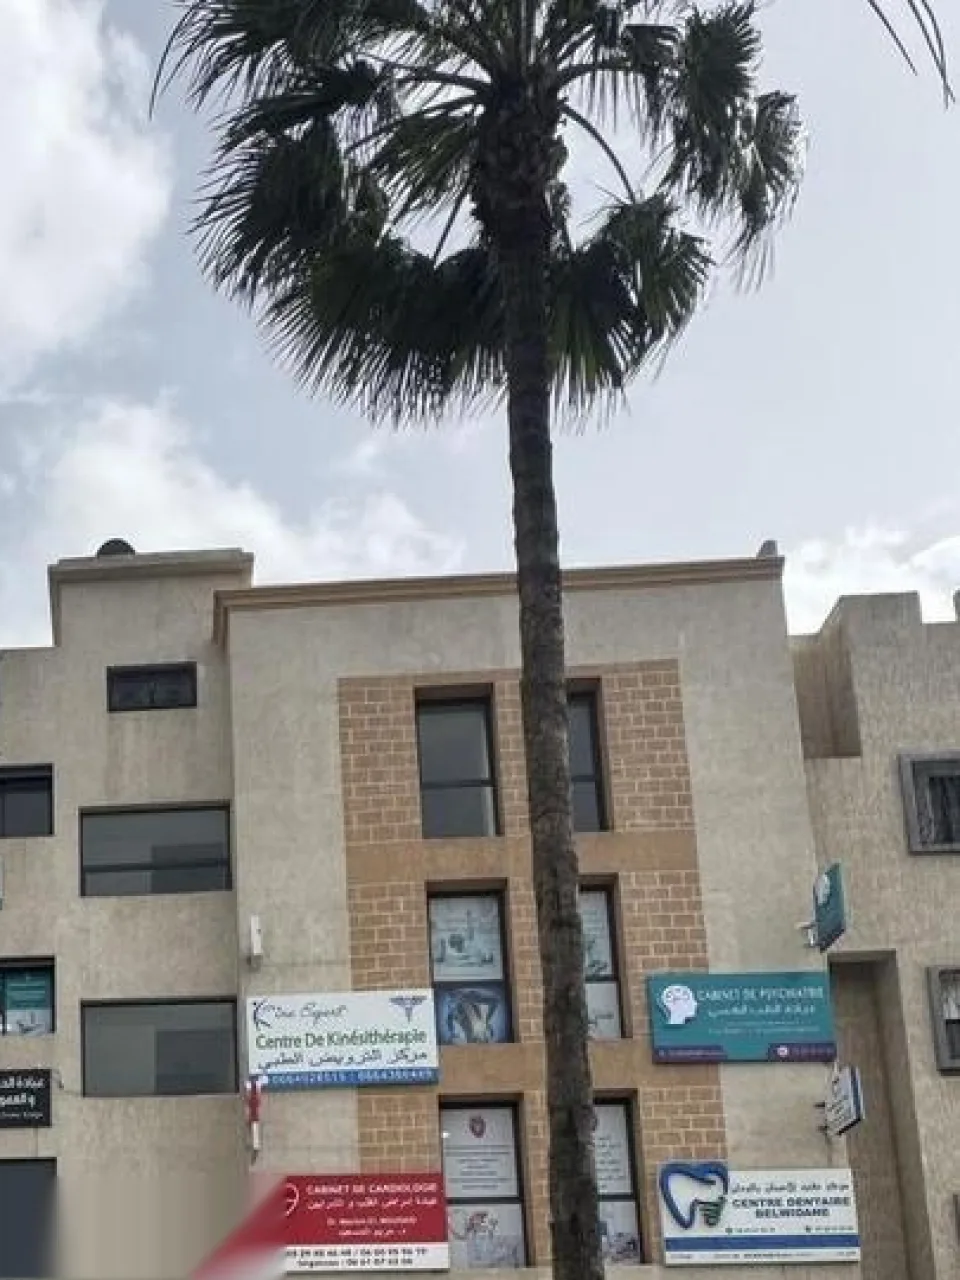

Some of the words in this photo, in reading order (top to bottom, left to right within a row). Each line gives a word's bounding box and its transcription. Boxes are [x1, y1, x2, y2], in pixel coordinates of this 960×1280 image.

[256, 1033, 302, 1050] Centre
[305, 1032, 325, 1048] De
[387, 1048, 428, 1065] مركز
[305, 1184, 350, 1195] CABINET
[352, 1184, 366, 1194] DE
[368, 1182, 438, 1194] CARDIOLOGIE
[732, 1198, 782, 1208] CENTRE
[787, 1196, 850, 1207] DENTAIRE
